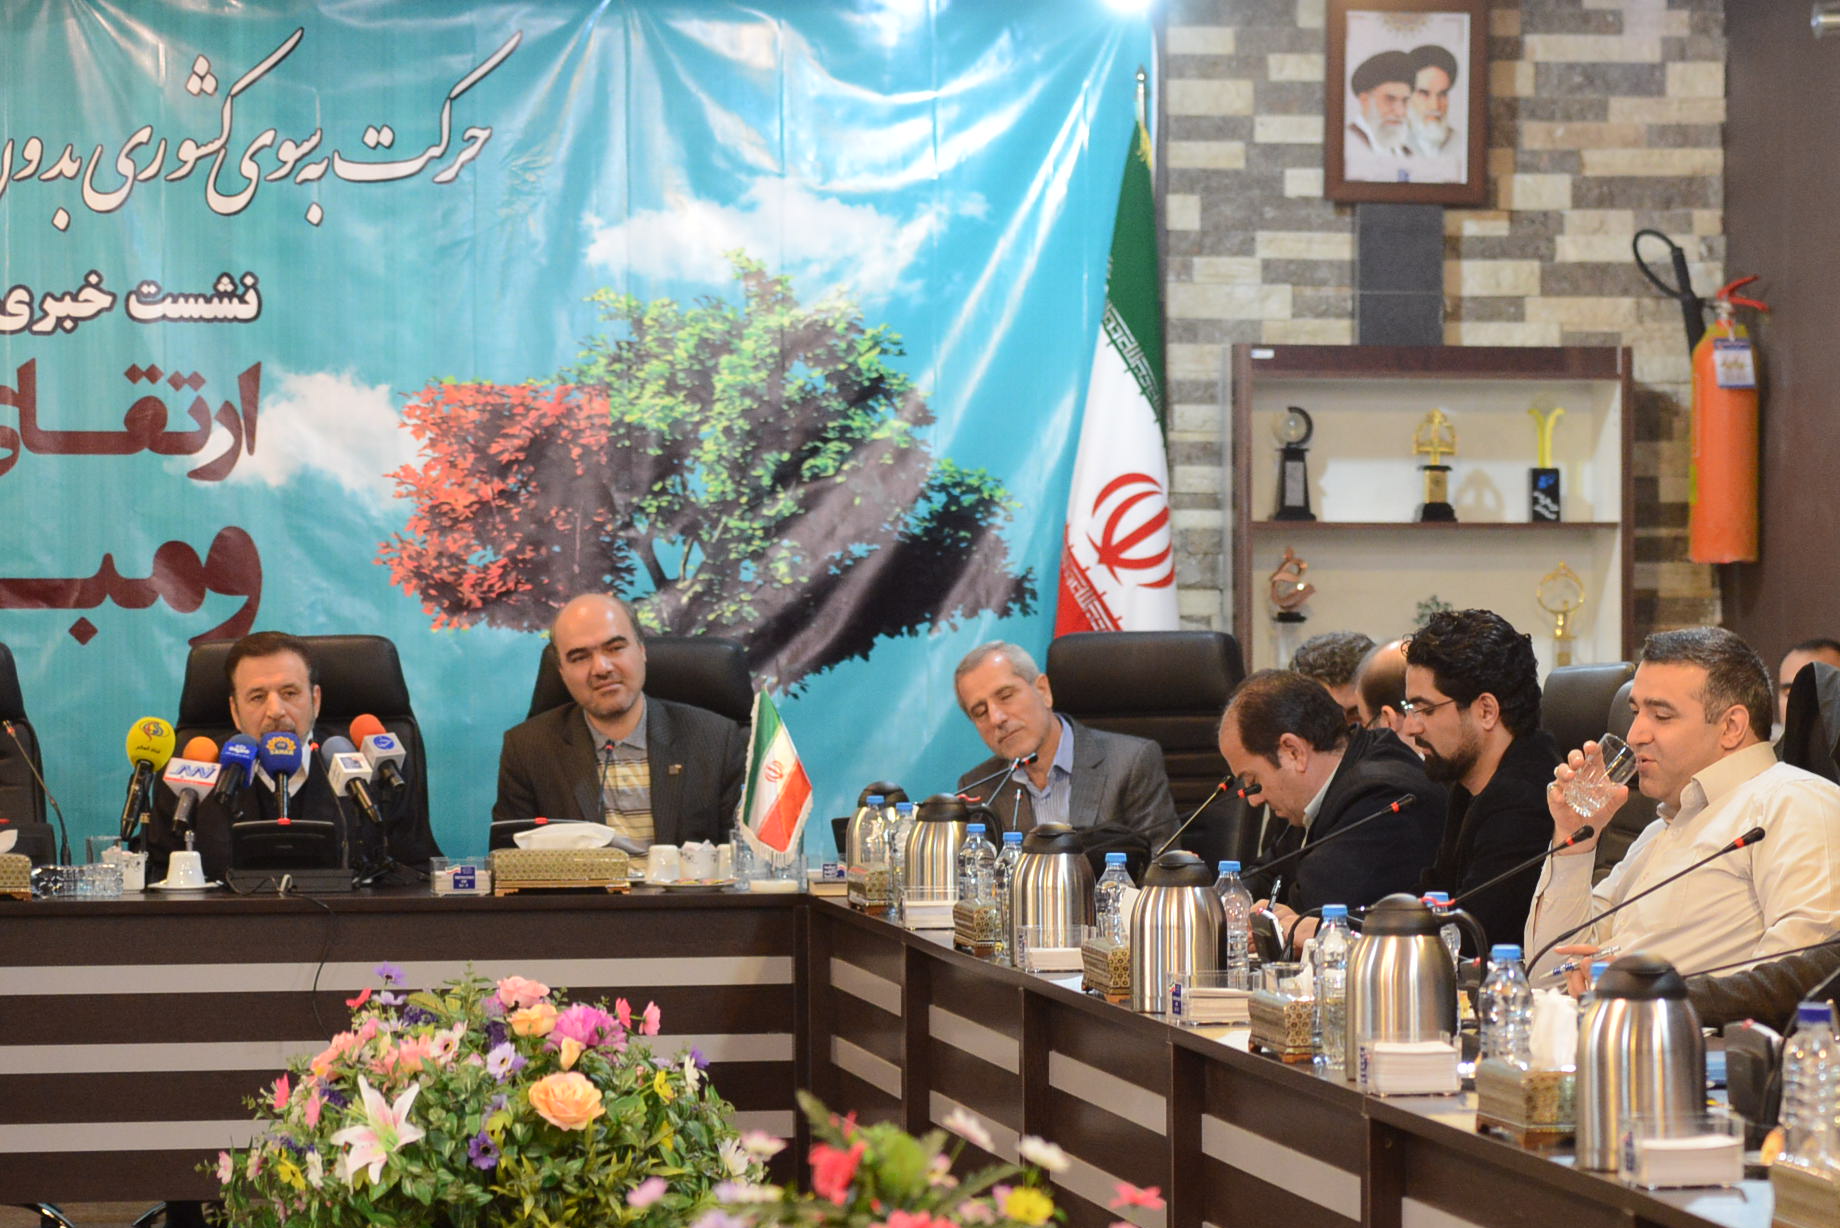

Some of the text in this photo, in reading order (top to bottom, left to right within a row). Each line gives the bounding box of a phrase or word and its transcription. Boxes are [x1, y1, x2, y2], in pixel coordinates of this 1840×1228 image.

[82, 26, 305, 214] کشوری
[332, 29, 524, 184] حرکت
[125, 272, 263, 324] نشست
[0, 357, 262, 482] ارتقا
